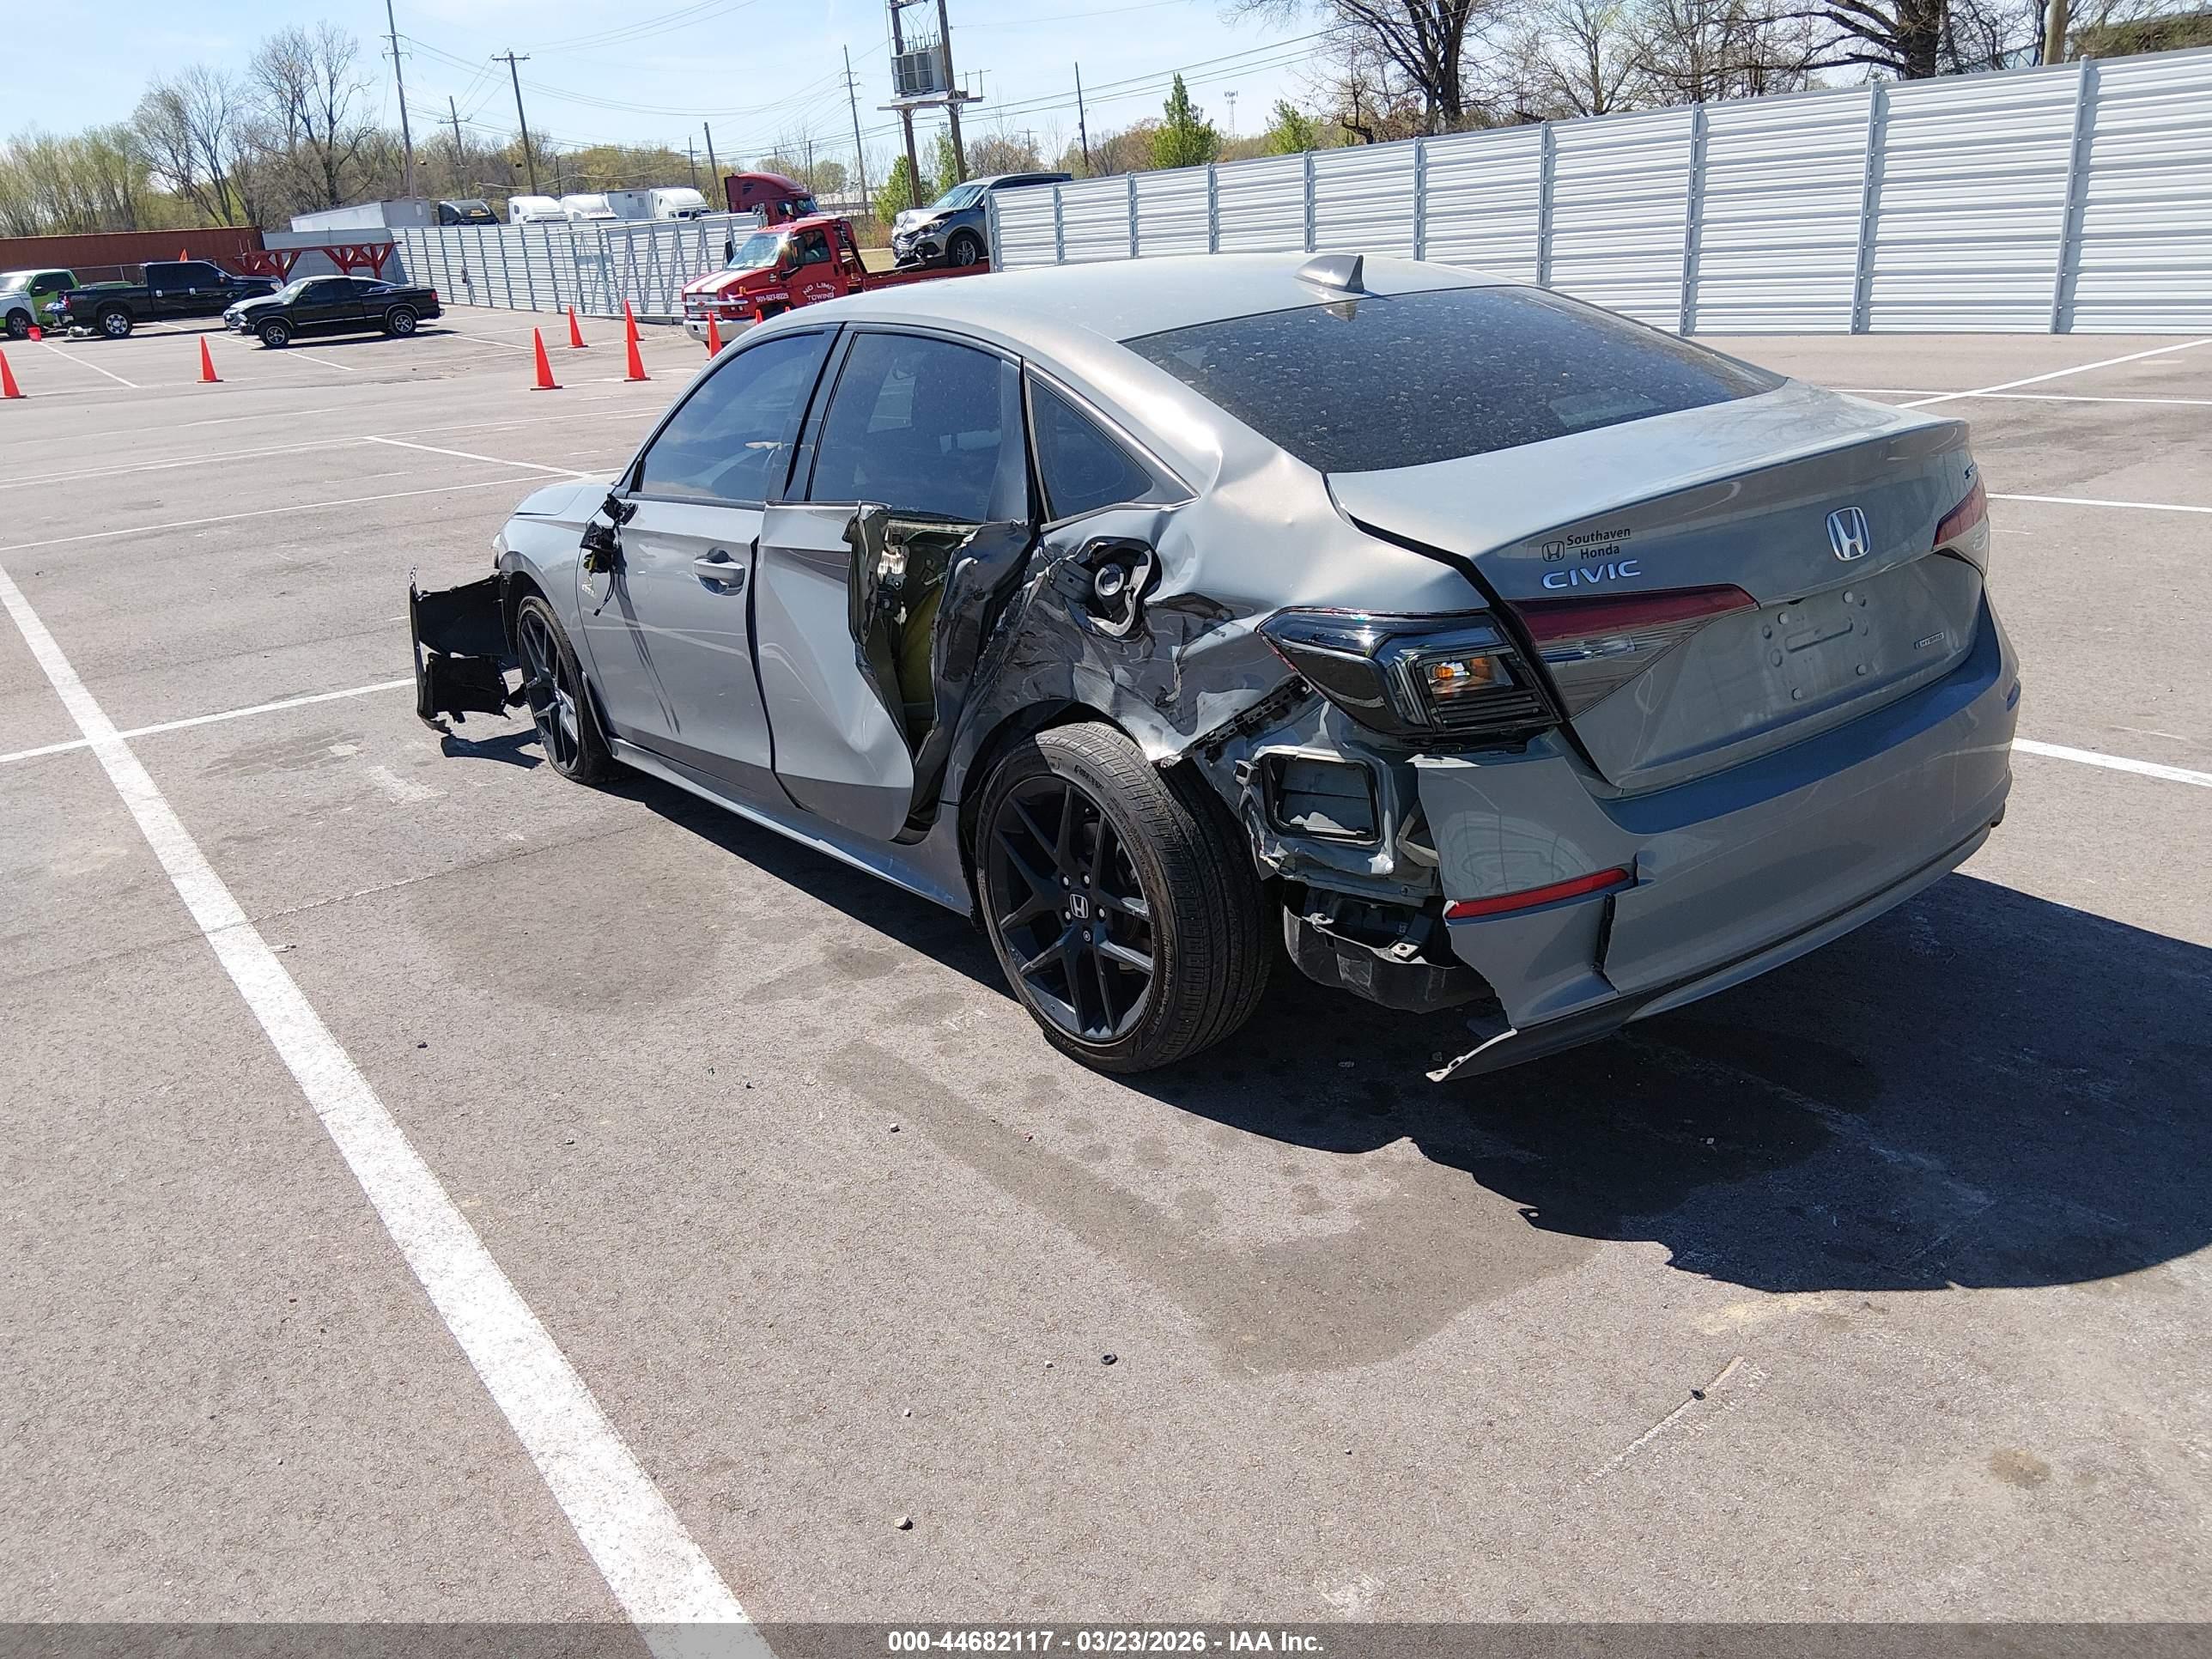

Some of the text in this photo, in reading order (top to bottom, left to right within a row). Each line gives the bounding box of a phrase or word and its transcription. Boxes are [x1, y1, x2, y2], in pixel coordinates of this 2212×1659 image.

[802, 283, 836, 295] NO LIMIT
[806, 292, 835, 301] TOWING
[1566, 528, 1631, 546] Southaven
[1580, 544, 1620, 560] Honda
[1542, 559, 1642, 589] CIVIC
[1922, 633, 1943, 646] HYBRID
